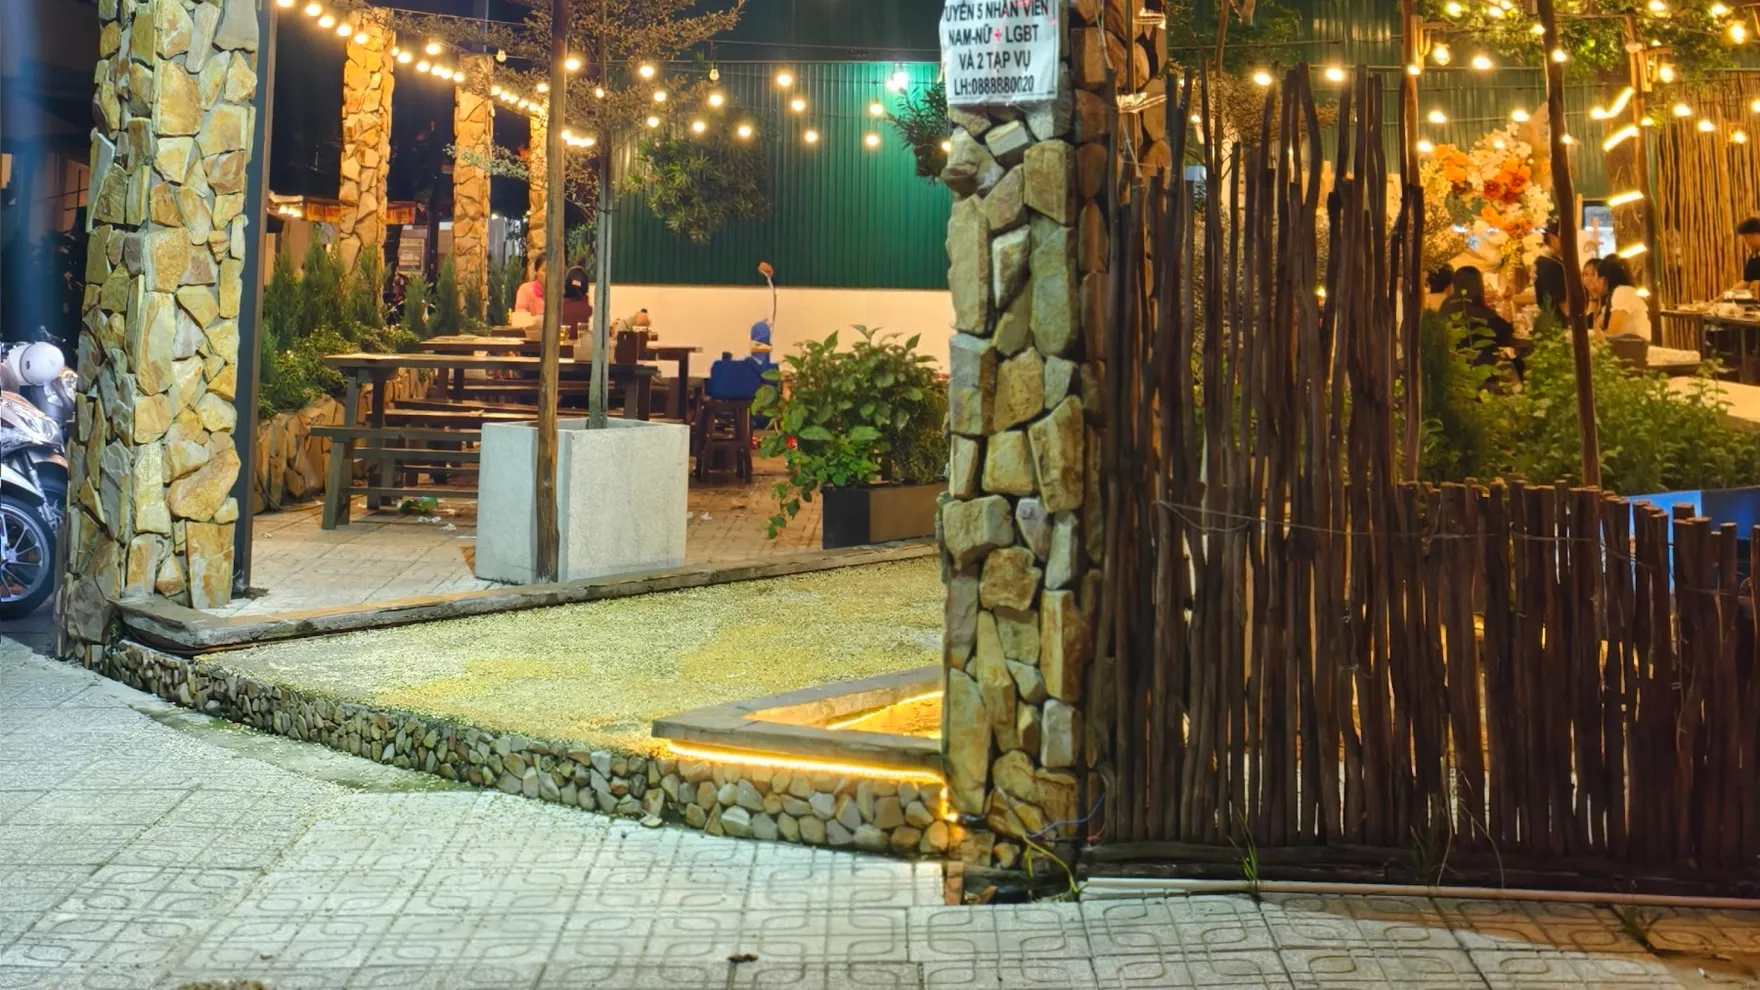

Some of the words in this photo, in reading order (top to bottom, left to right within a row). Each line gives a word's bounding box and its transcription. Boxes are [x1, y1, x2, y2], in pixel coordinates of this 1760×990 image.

[944, 0, 975, 21] UYỂN
[977, 3, 984, 20] 5
[1005, 24, 1039, 43] LGBT
[959, 49, 975, 70] VÀ
[977, 52, 984, 70] 2
[986, 51, 1011, 73] TẠP
[1014, 50, 1031, 72] VỤ
